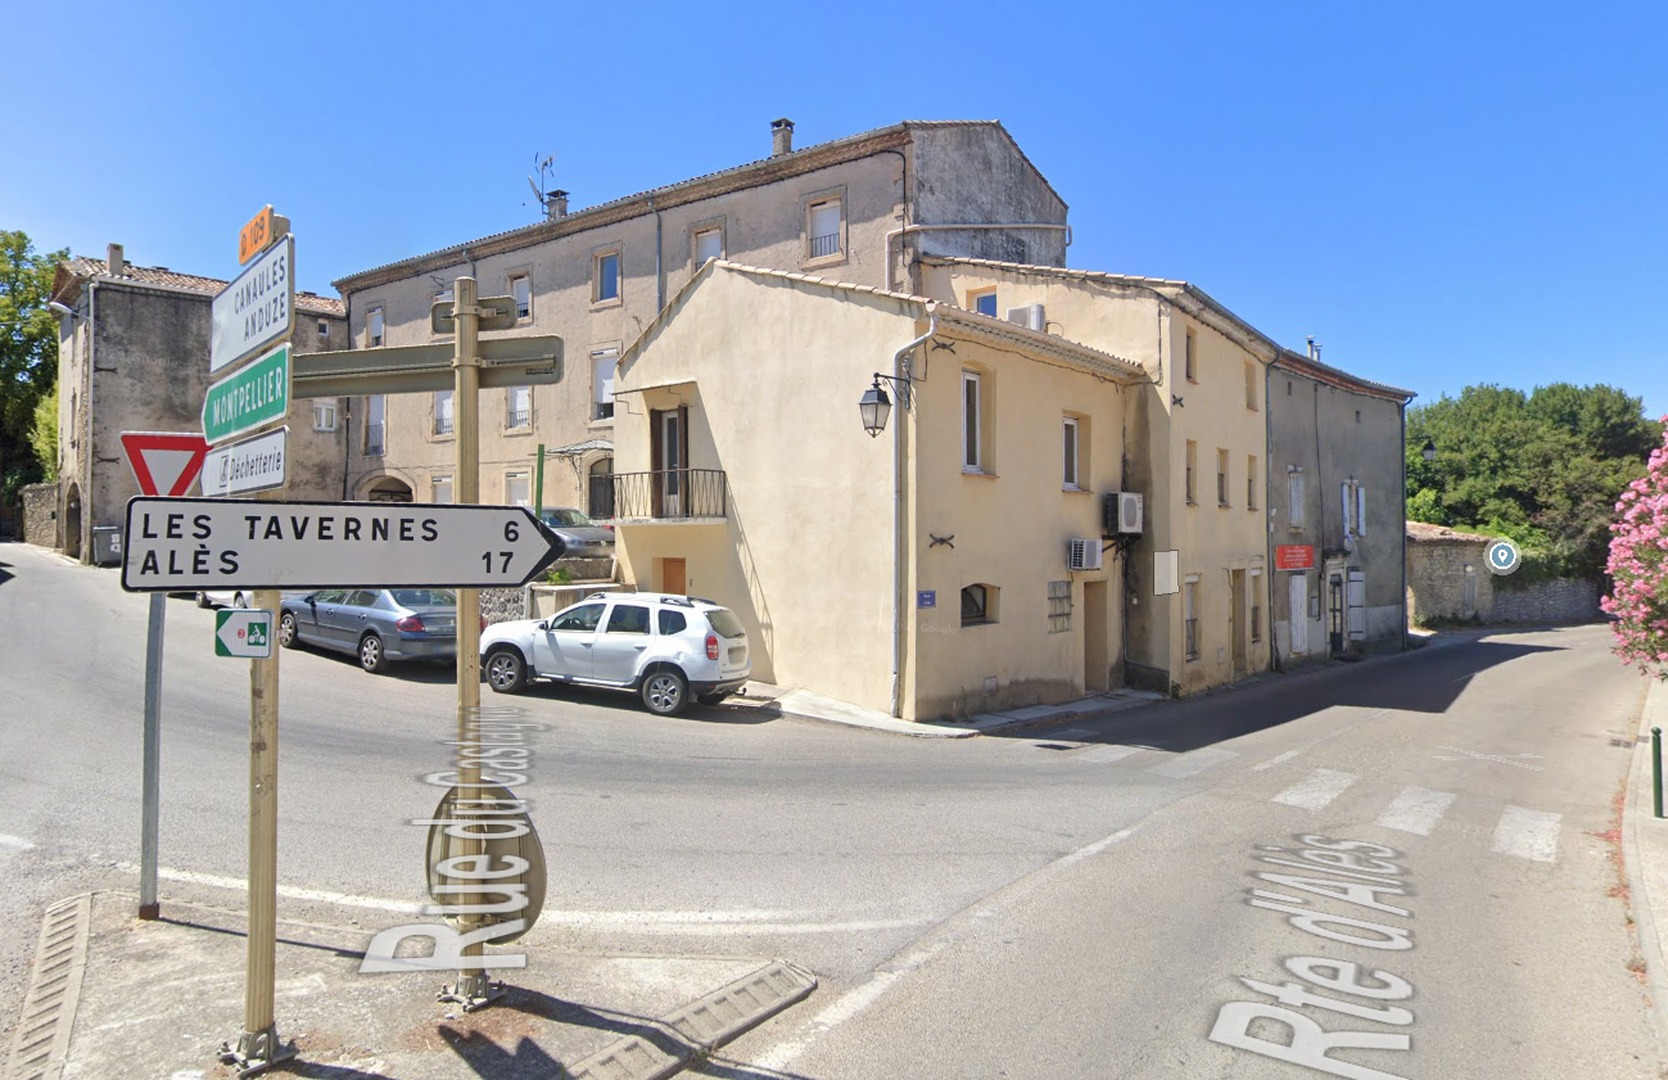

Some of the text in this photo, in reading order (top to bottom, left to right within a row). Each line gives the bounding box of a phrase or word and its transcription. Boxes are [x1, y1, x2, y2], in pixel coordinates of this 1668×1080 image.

[241, 216, 265, 256] D 109
[234, 256, 285, 315] CANAULES
[244, 292, 286, 341] ANDUZE
[213, 366, 282, 427] MONTPELLIER
[230, 446, 281, 481] Déchetterie
[142, 513, 519, 542] LES TAVERNES 6
[140, 543, 514, 575] ALÈS 17
